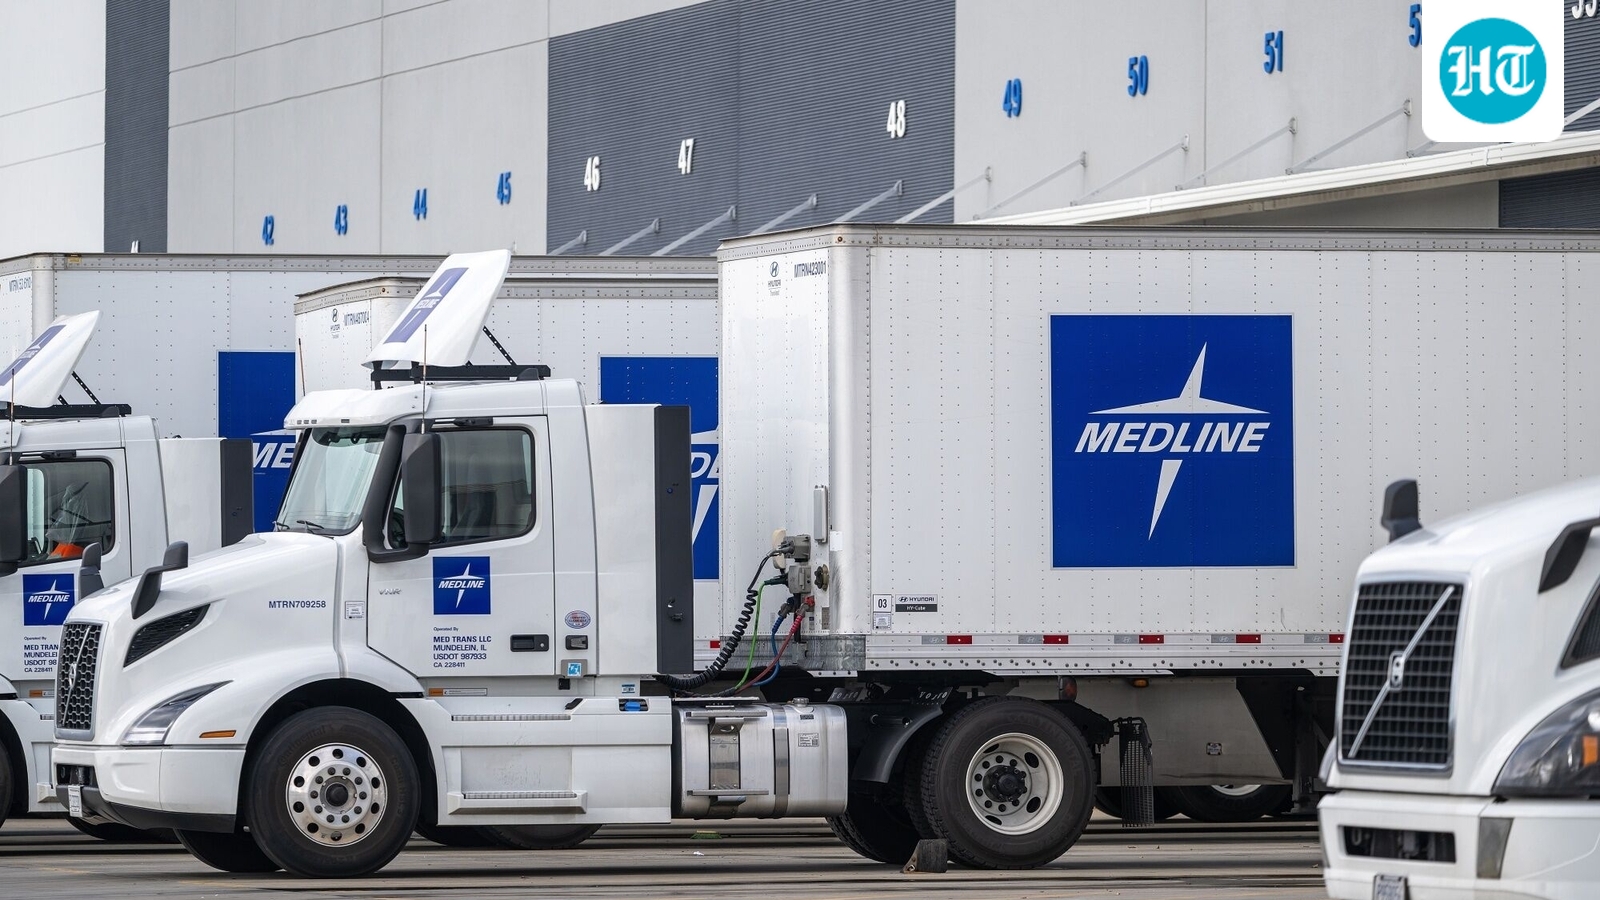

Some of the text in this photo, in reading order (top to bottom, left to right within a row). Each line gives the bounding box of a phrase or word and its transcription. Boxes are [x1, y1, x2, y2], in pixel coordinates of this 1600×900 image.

[1408, 3, 1422, 47] 5
[1264, 30, 1283, 74] 51
[1127, 55, 1149, 97] 50
[1002, 78, 1022, 118] 49
[886, 99, 906, 138] 48
[678, 138, 694, 174] 47
[497, 171, 512, 205] 45
[584, 156, 600, 191] 46
[334, 204, 348, 235] 43
[413, 188, 428, 220] 44
[262, 215, 274, 245] 42
[1074, 422, 1271, 453] MEDLINE
[253, 442, 296, 468] ME
[28, 594, 70, 603] MEDLINE
[437, 580, 485, 589] MEDLINE
[268, 600, 327, 609] MTRN709258
[877, 598, 888, 609] 03
[433, 644, 478, 652] MUNDELEIN,
